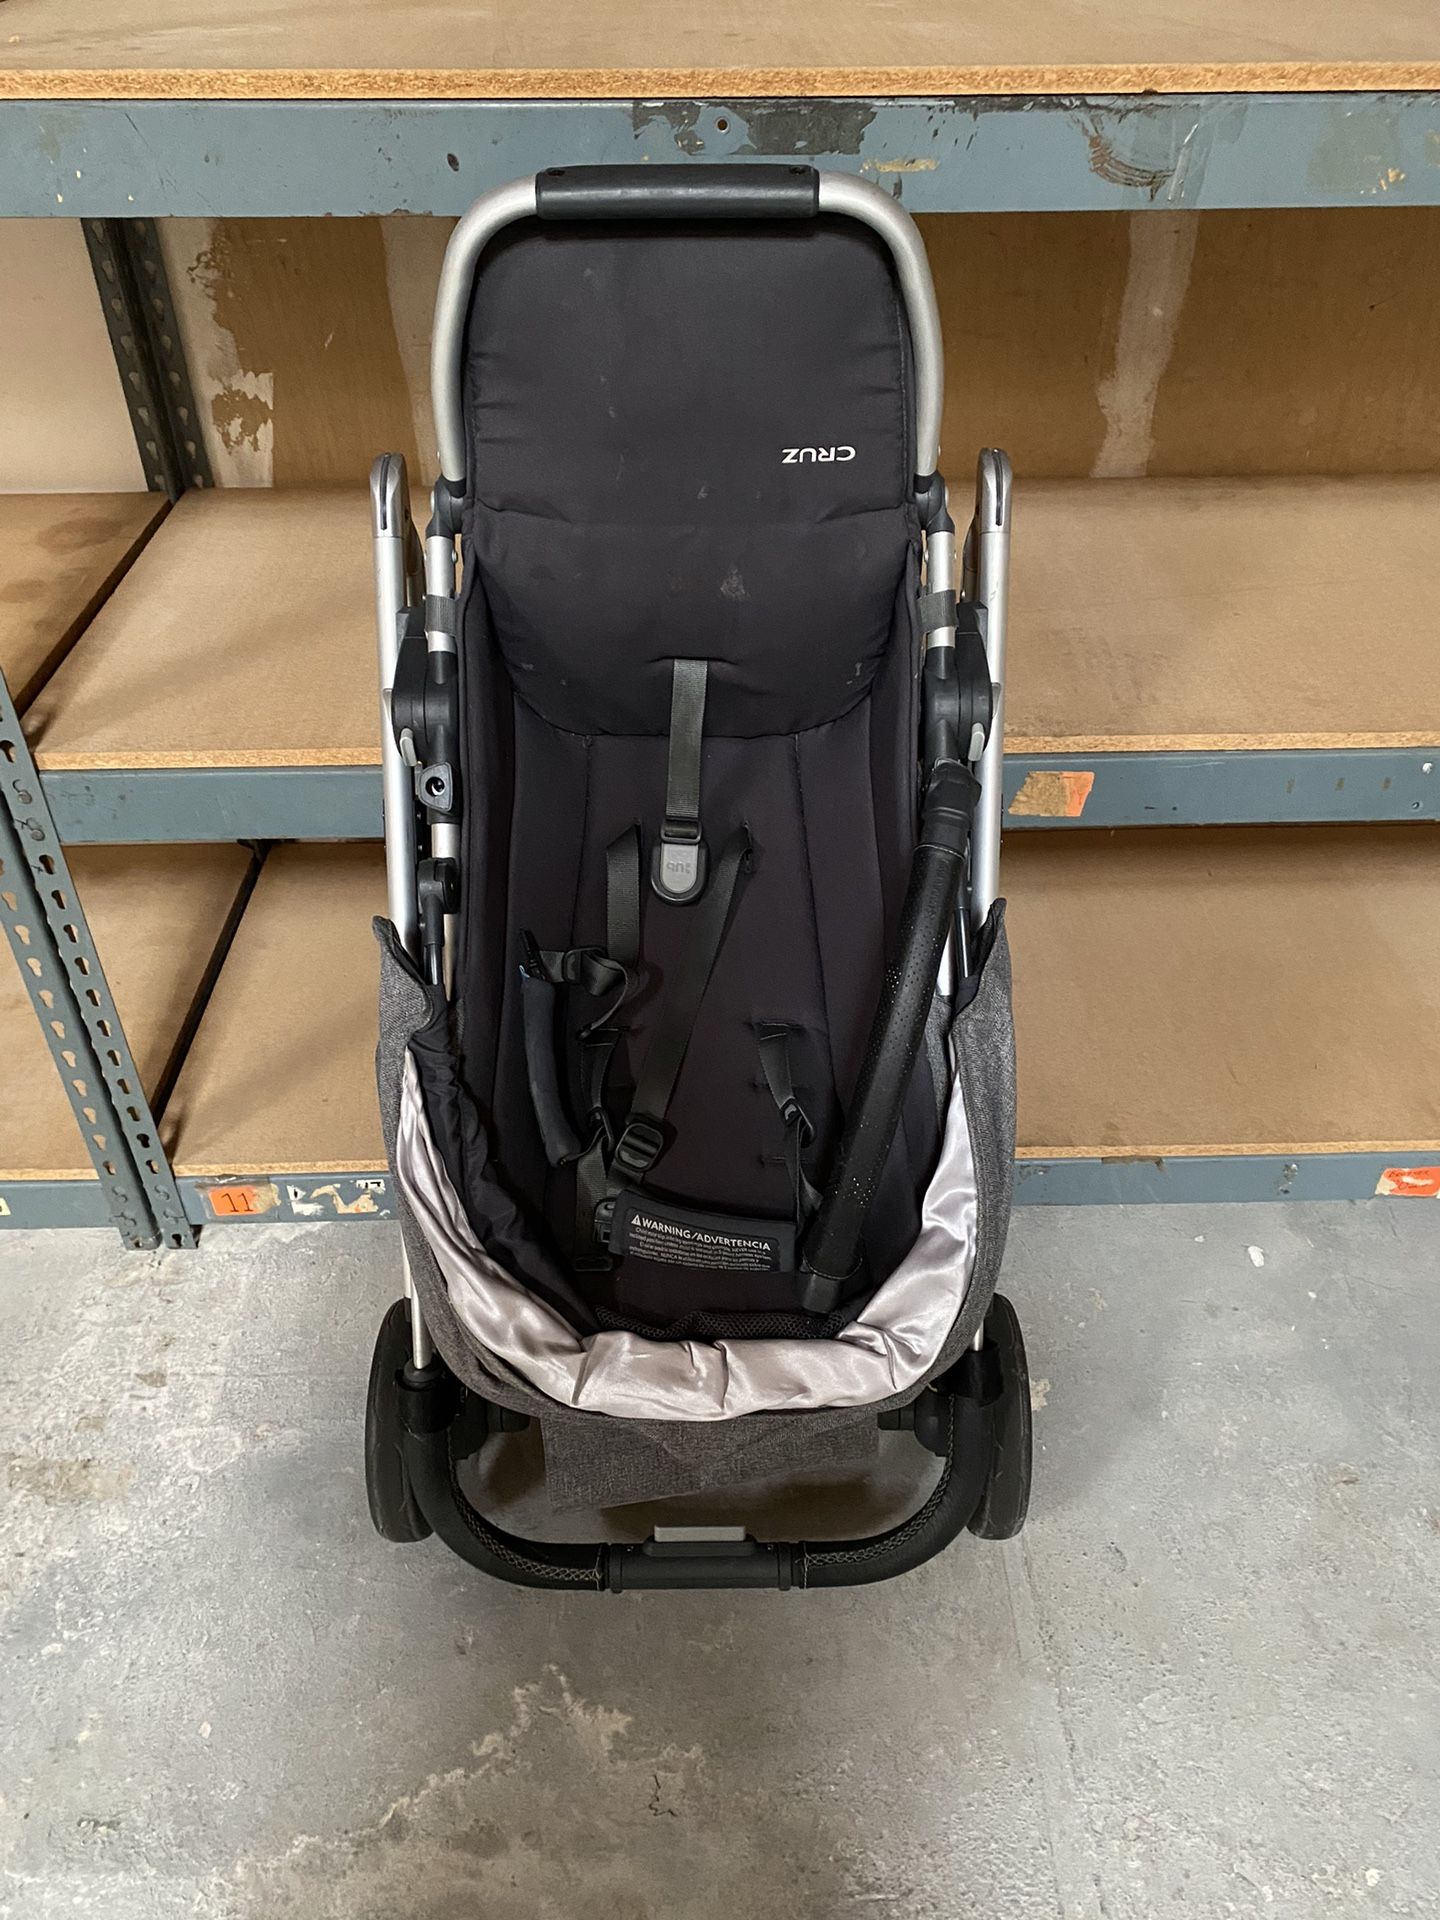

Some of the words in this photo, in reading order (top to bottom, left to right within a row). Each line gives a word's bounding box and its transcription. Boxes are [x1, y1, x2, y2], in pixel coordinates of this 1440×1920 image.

[782, 445, 856, 464] CRUZ
[221, 1192, 254, 1213] 11
[642, 1217, 771, 1251] WARNING/ADVERTENCIA
